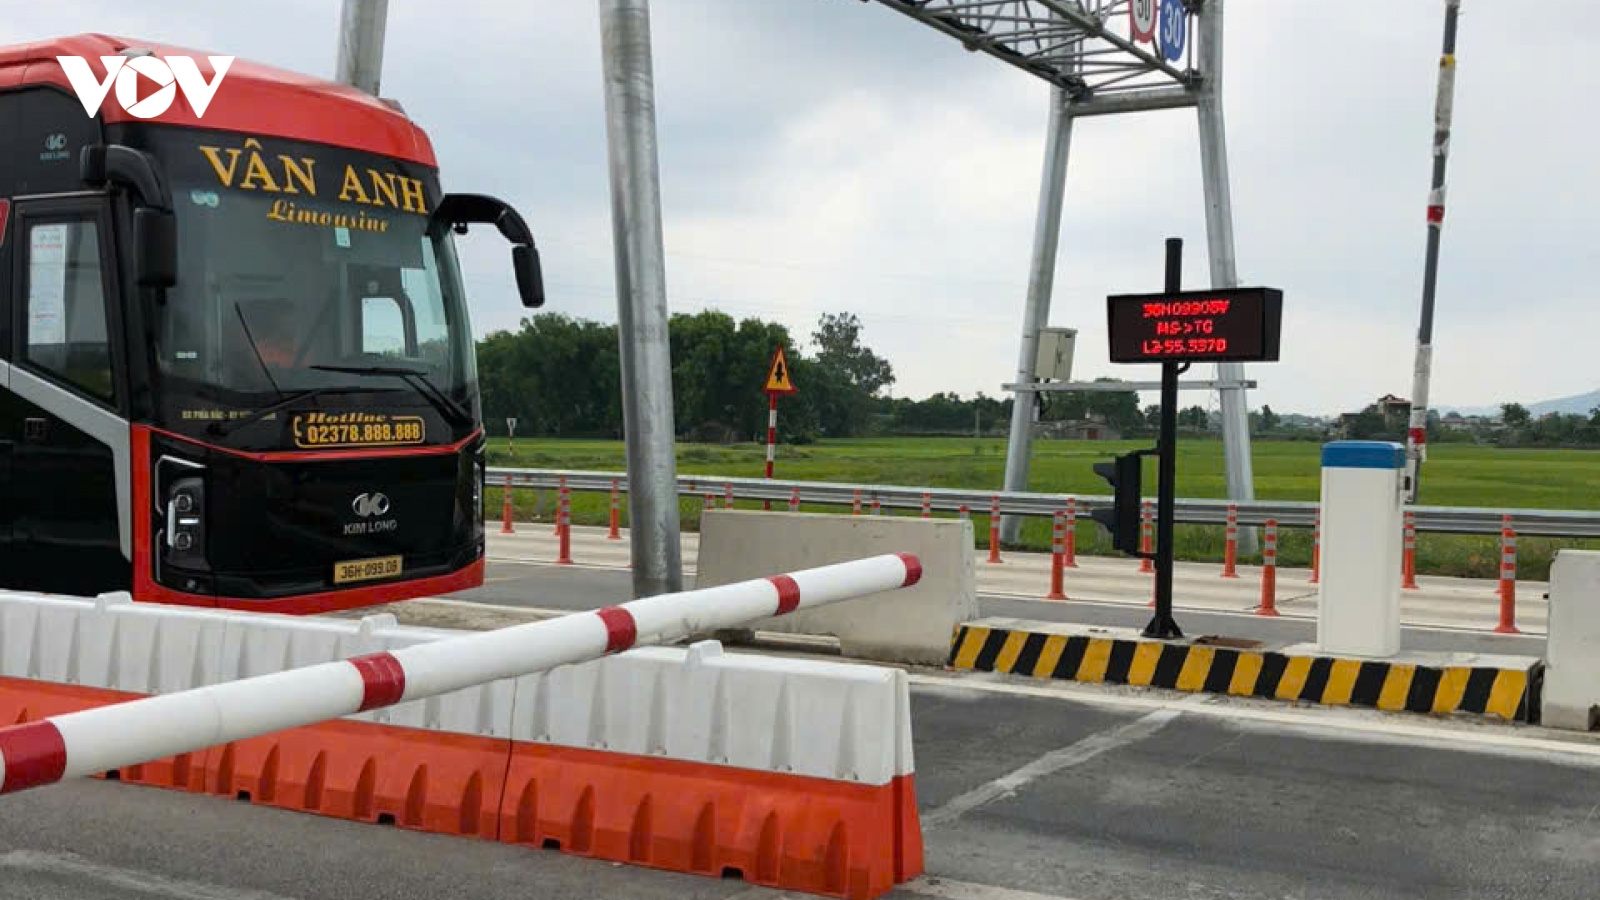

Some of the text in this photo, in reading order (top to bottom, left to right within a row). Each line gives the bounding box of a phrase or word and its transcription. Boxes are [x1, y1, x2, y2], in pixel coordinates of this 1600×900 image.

[1164, 2, 1182, 48] 30
[199, 137, 429, 215] VÂN ANH
[266, 199, 389, 232] Limousine
[306, 412, 387, 424] Hotline
[307, 422, 421, 444] 02378.888.888
[342, 519, 398, 535] KIM LONG
